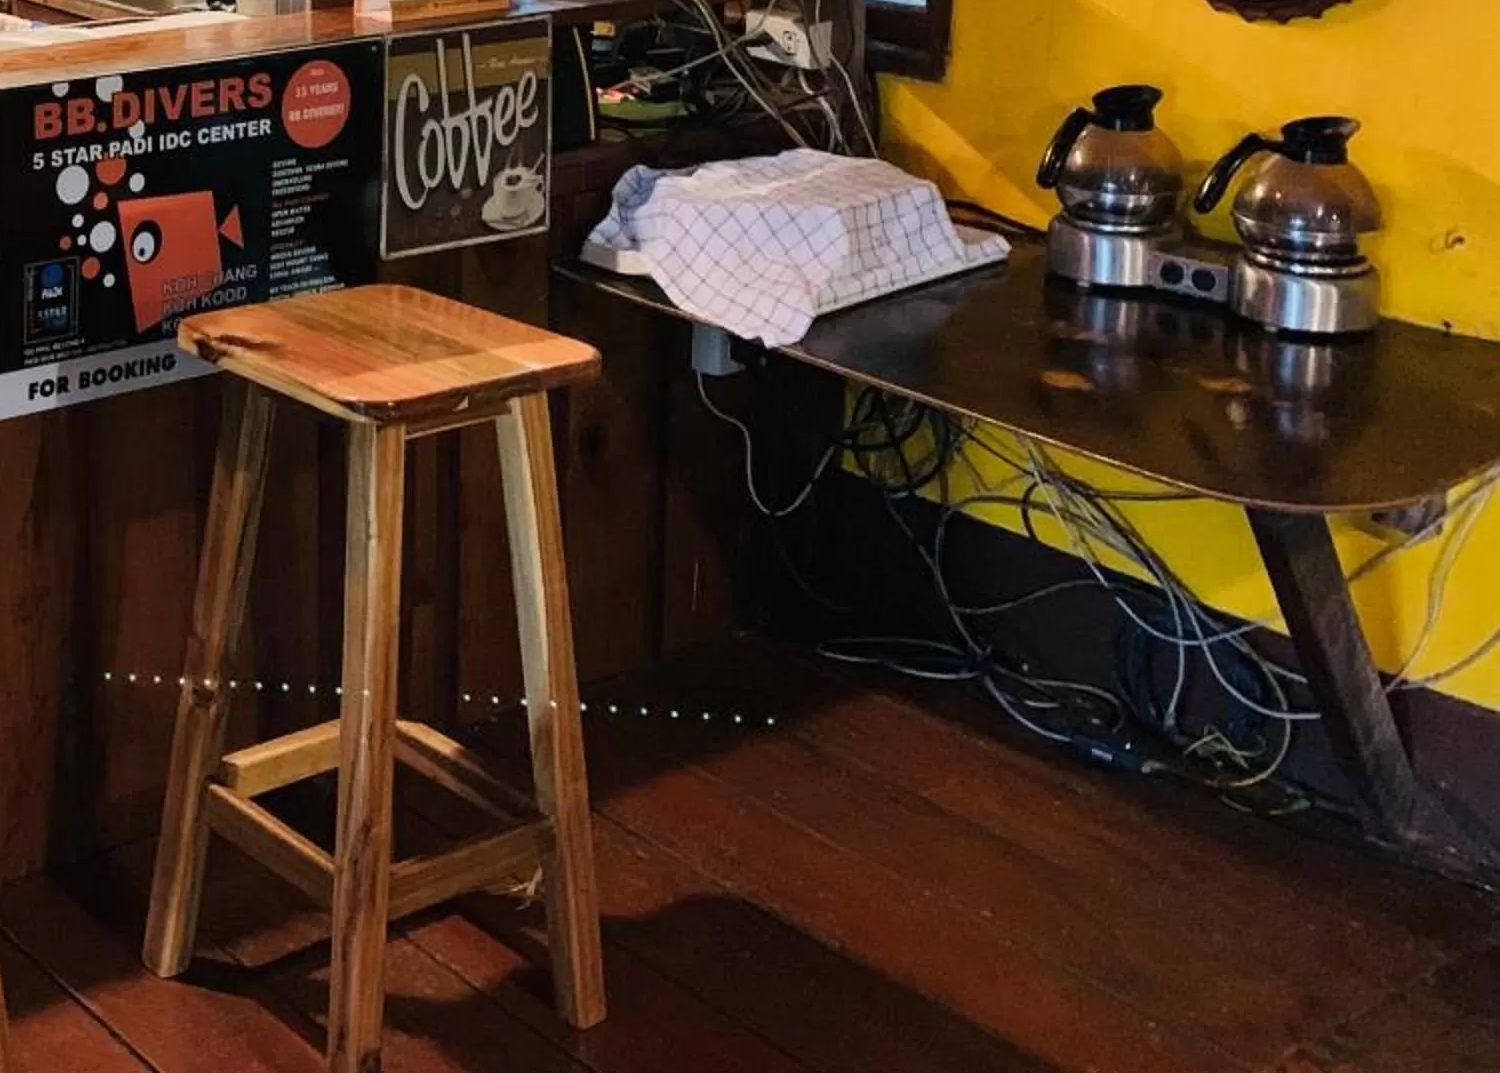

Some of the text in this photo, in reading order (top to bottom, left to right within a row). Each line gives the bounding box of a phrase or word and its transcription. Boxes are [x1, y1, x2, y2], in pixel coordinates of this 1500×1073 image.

[33, 118, 272, 170] 5 STAR PADI IDC CENTER
[28, 376, 70, 401] FOR
[78, 353, 177, 390] BOOKING
